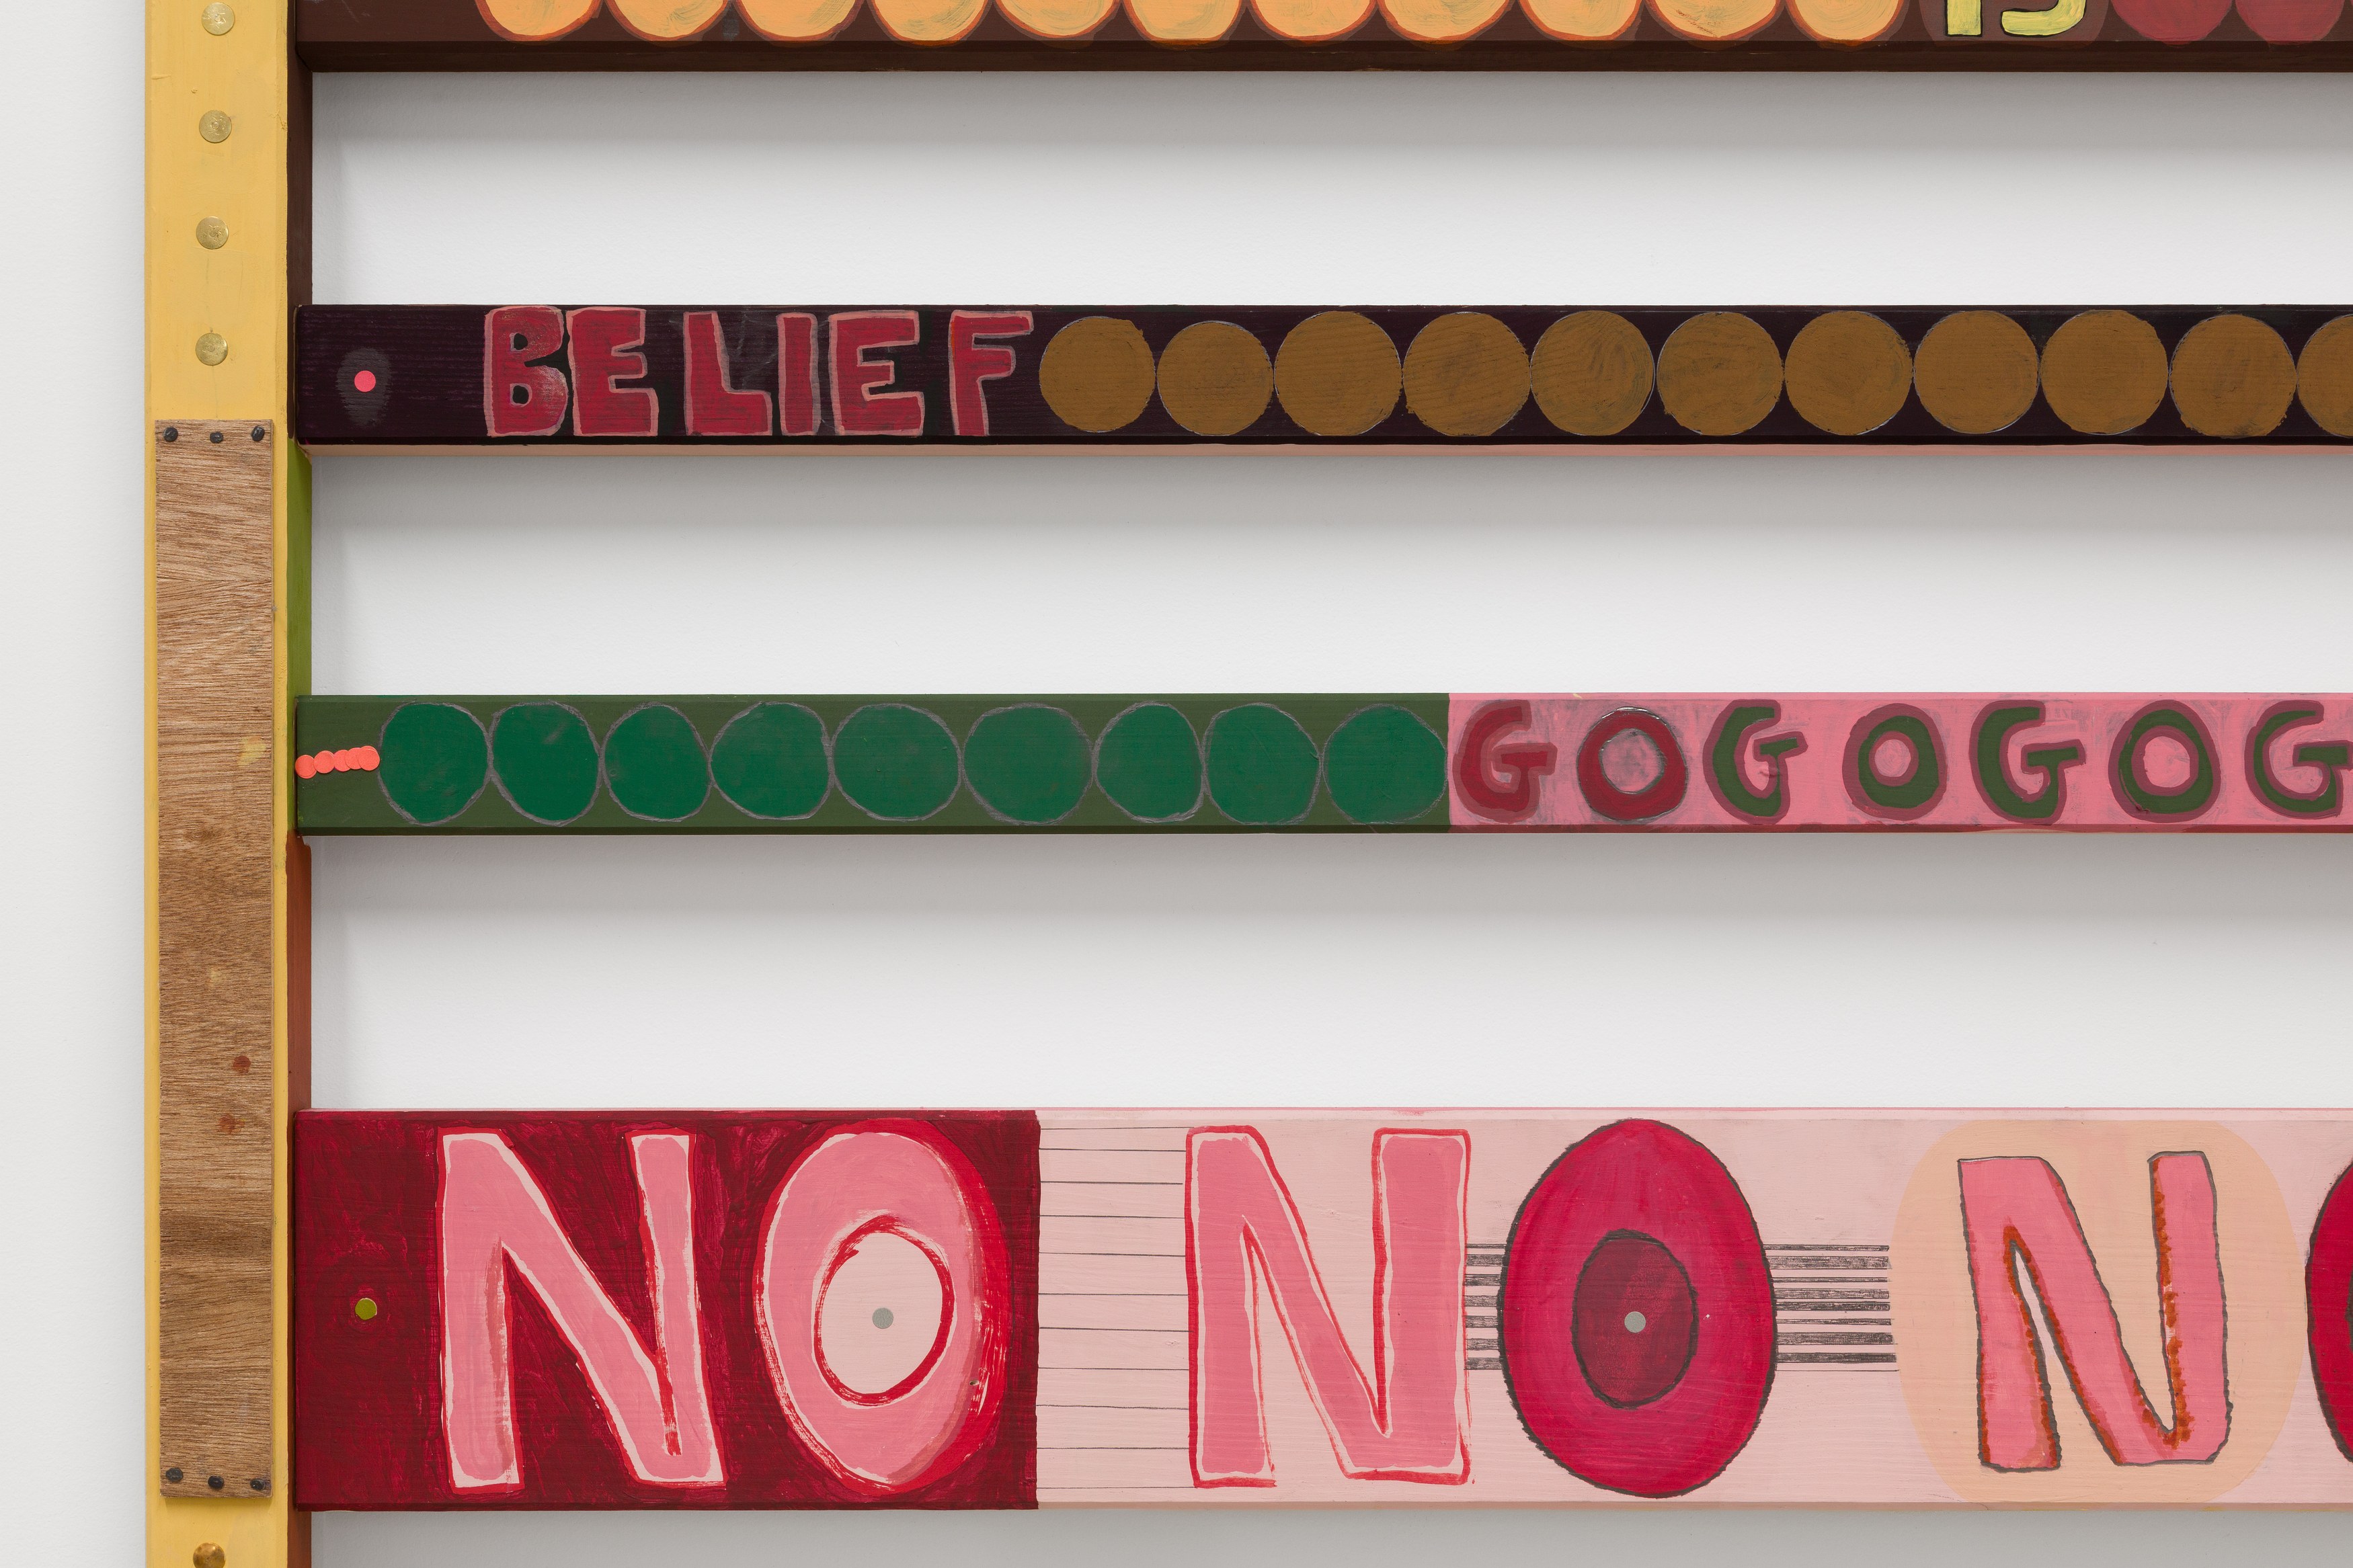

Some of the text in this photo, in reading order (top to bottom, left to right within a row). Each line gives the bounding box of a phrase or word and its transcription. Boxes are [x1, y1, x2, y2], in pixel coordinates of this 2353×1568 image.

[483, 306, 1035, 437] BELIEF
[436, 1118, 2353, 1499] NO NO N
